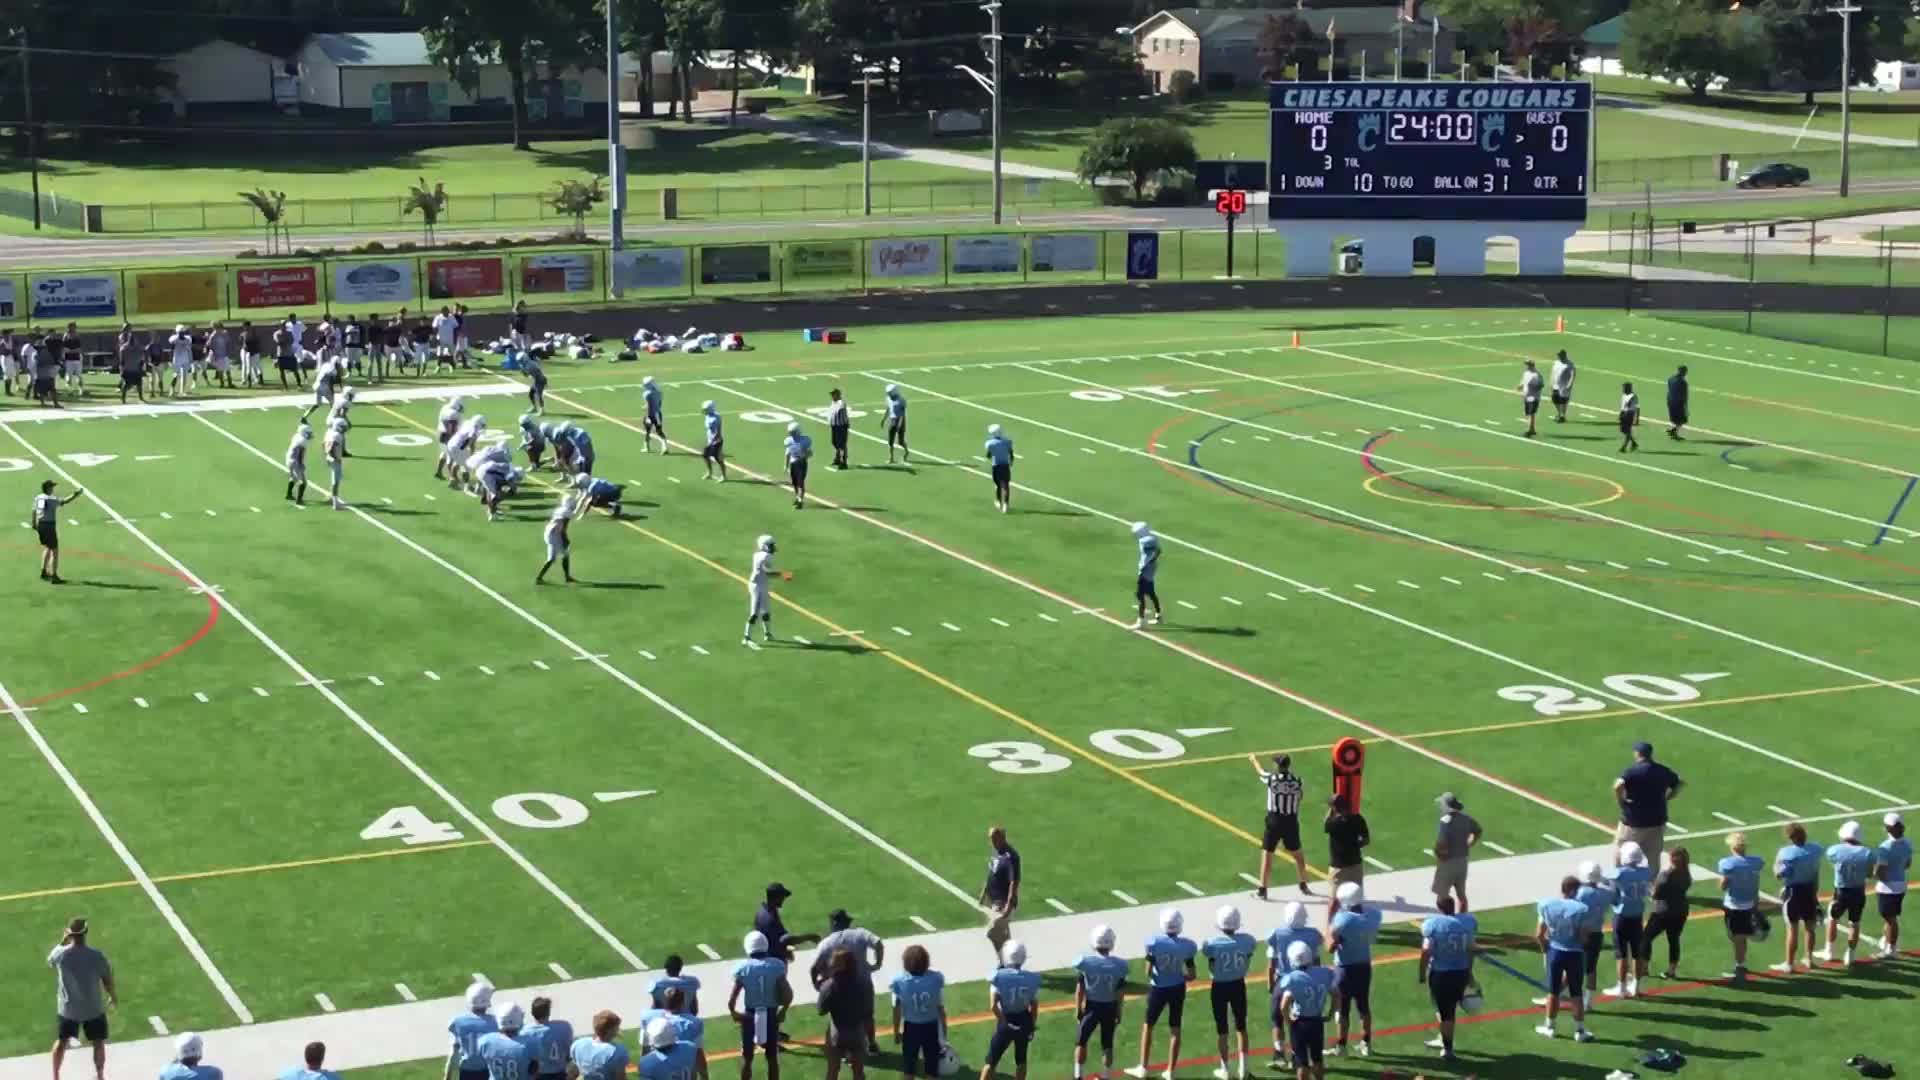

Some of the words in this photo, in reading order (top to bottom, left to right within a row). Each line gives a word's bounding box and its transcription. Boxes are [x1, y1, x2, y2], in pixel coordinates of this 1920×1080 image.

[1284, 88, 1449, 109] CHESAPEAKE
[1457, 88, 1577, 108] COUGARS
[1295, 111, 1334, 124] HOME
[1526, 111, 1561, 125] GUEST
[1390, 113, 1474, 141] 24:00
[1310, 125, 1328, 152] 0
[1551, 125, 1569, 152] 0
[1323, 155, 1333, 170] 3
[1524, 155, 1534, 170] 3
[1295, 176, 1324, 189] DOWN
[1353, 174, 1373, 192] 10
[1383, 176, 1397, 189] TO
[1398, 176, 1414, 189] GO
[1434, 176, 1461, 189] BALL
[1464, 176, 1478, 189] ON
[1483, 174, 1509, 192] 31
[1534, 176, 1558, 189] QTR
[1217, 195, 1244, 212] 20
[1219, 951, 1246, 973] 26
[757, 974, 766, 993] 1
[549, 1043, 562, 1062] 4
